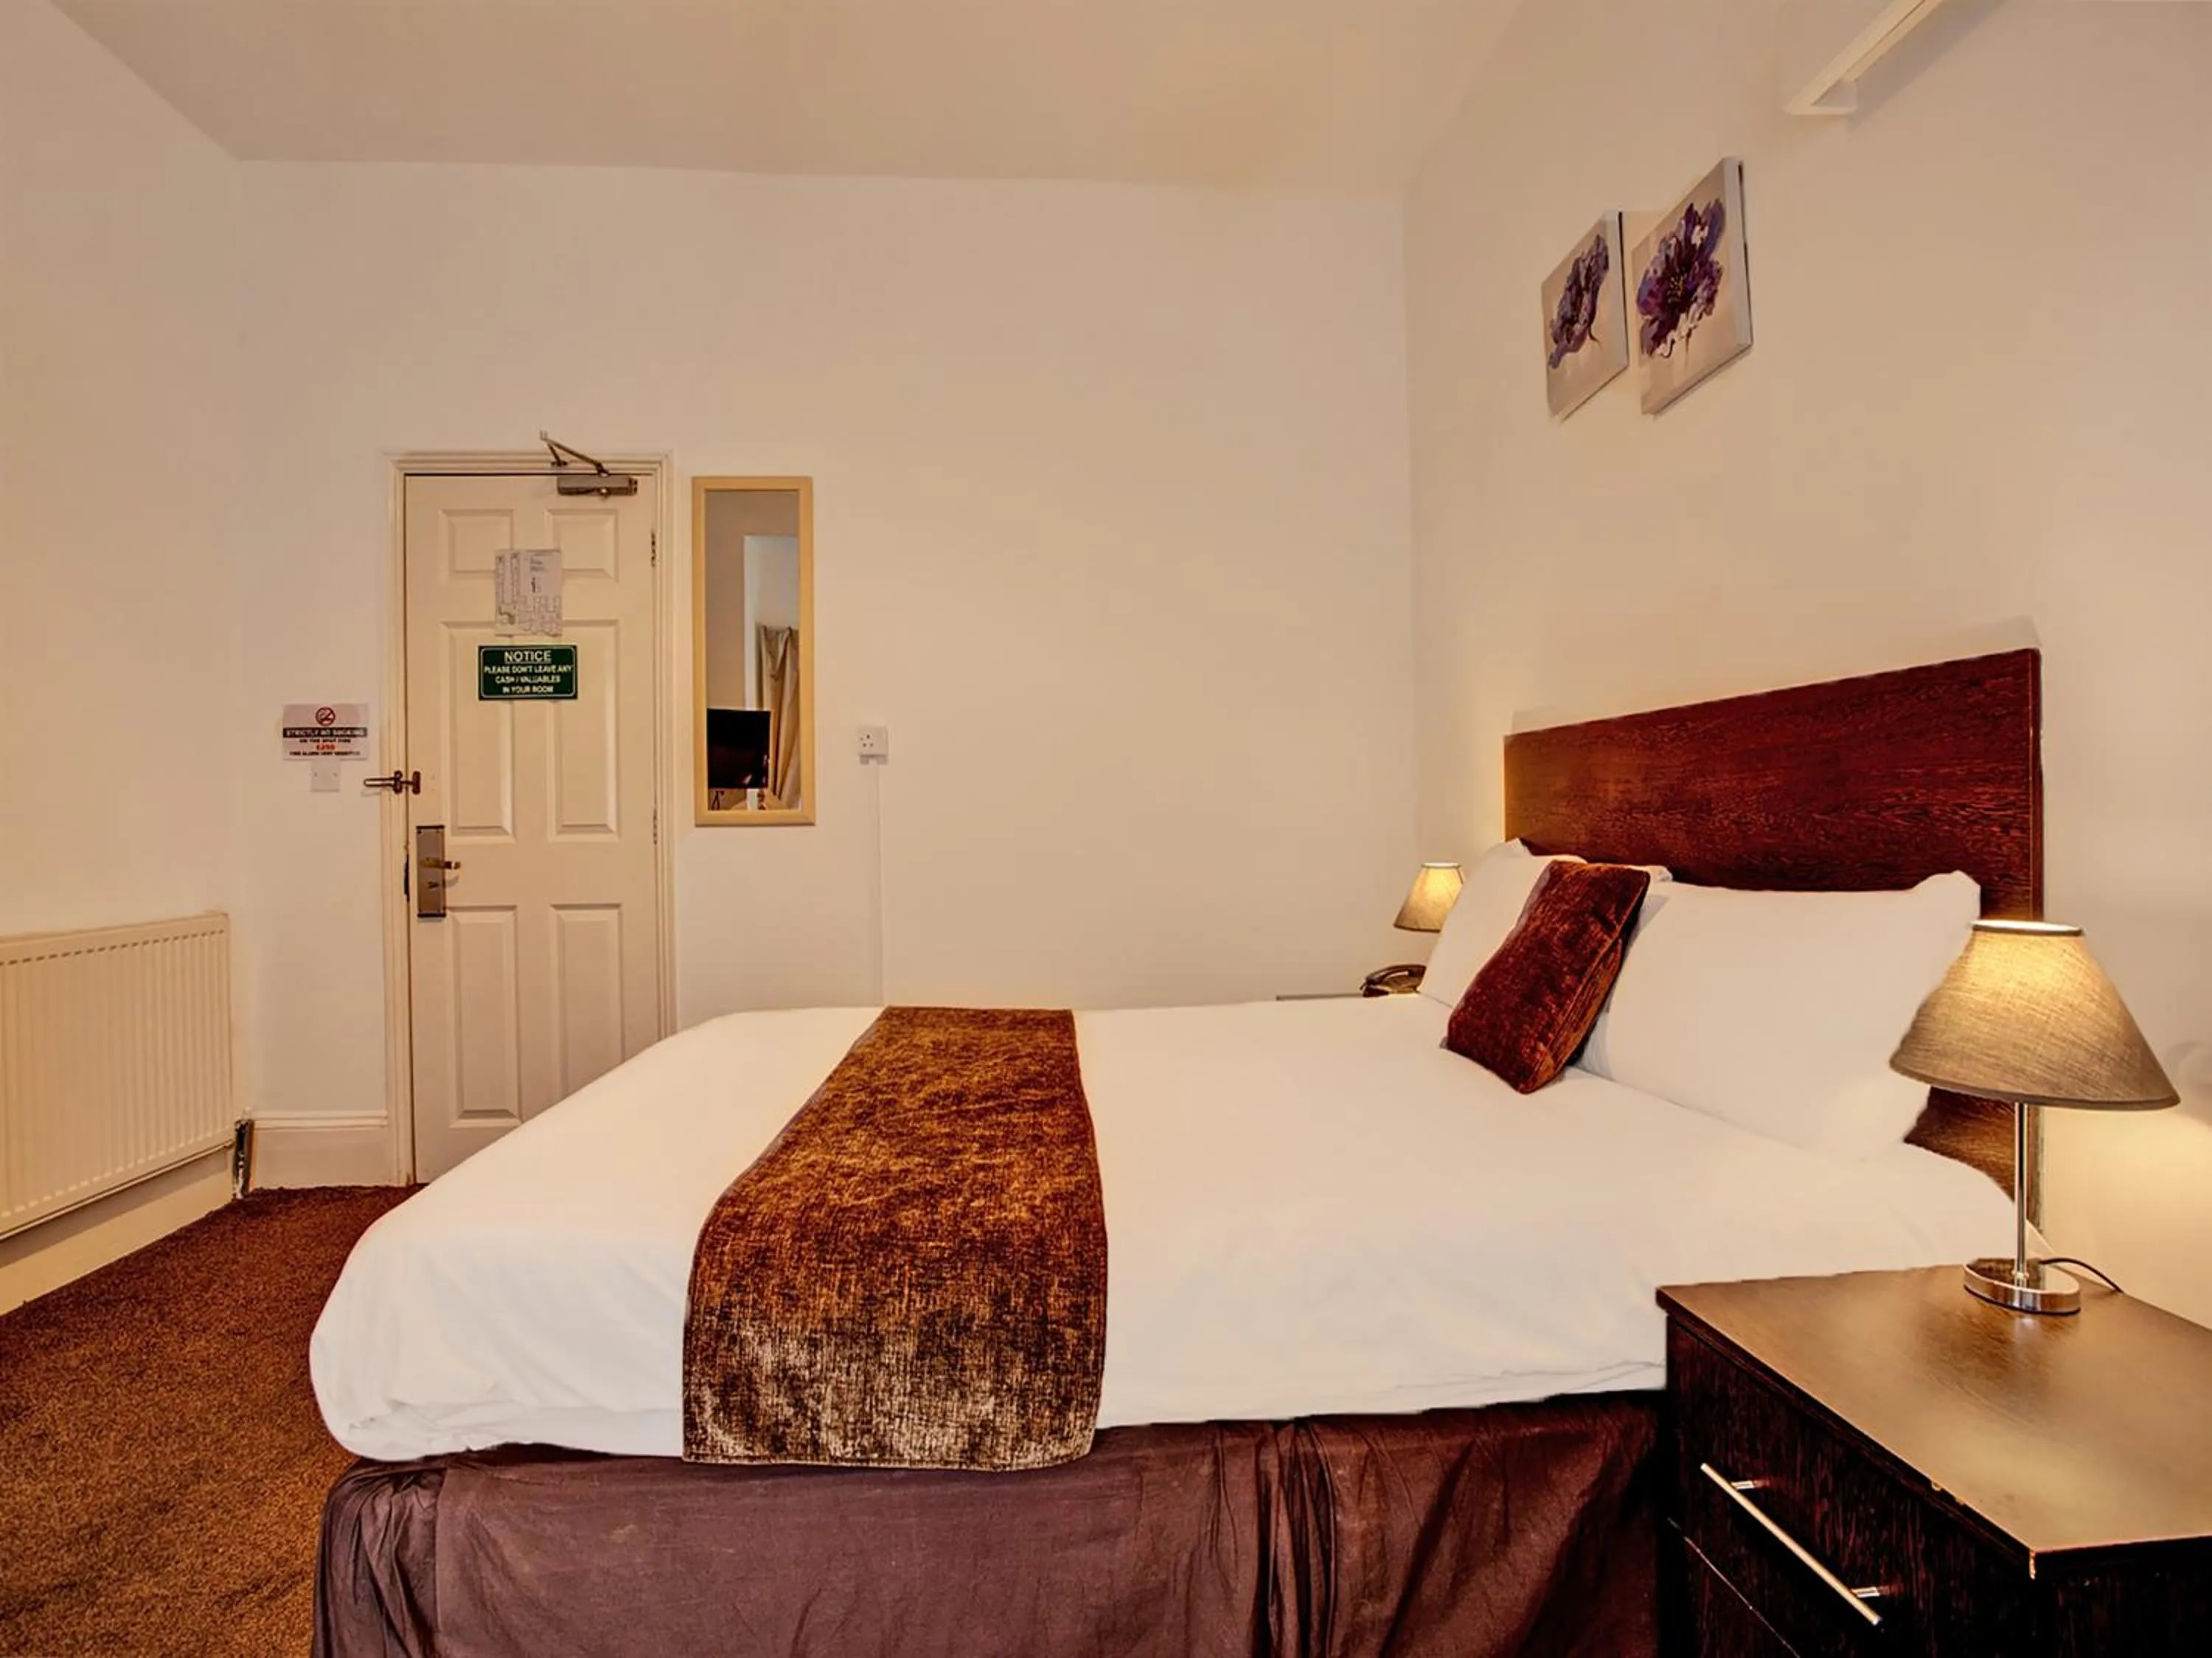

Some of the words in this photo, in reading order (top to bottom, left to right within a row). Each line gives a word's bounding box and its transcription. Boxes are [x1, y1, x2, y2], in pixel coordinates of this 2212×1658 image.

[504, 650, 552, 661] NOTICE
[484, 665, 509, 673] PLEASE
[534, 665, 556, 673] LEAVE
[495, 675, 515, 684] CASH
[511, 685, 531, 693] YOUR
